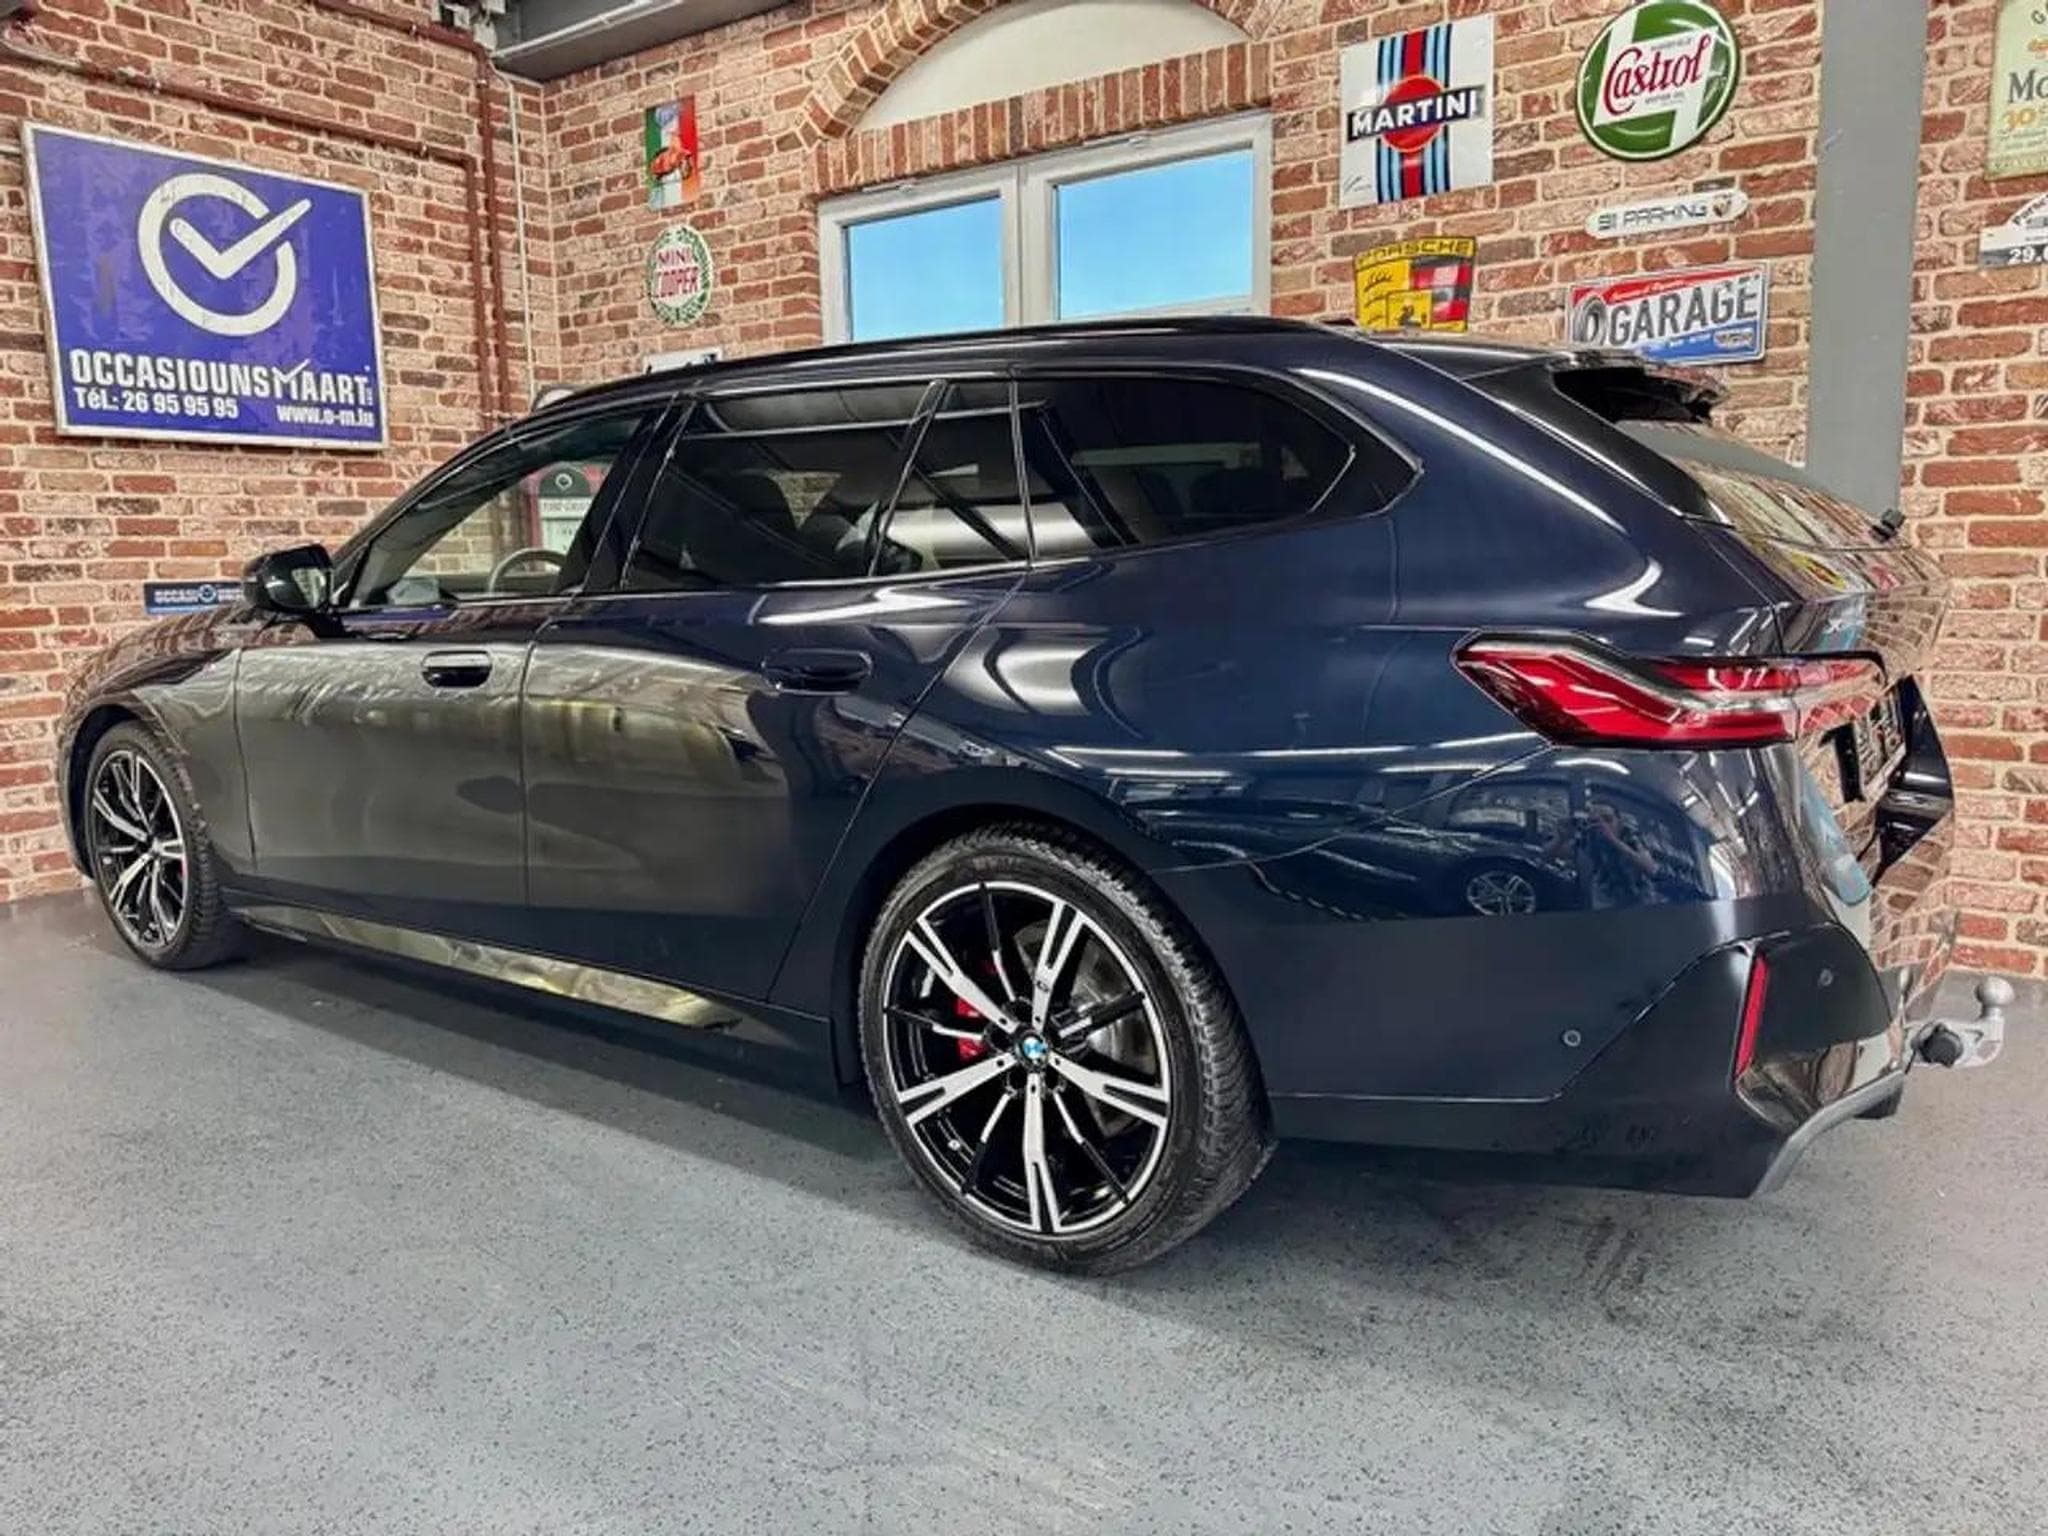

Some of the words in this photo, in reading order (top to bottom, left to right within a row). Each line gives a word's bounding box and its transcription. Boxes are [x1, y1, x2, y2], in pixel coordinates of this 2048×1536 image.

[1603, 34, 1712, 116] Castrol
[1352, 90, 1477, 137] MARTINI
[1623, 201, 1708, 227] PARKING
[658, 246, 692, 264] MINI
[1359, 240, 1470, 266] PORSCHE
[655, 266, 699, 298] COOPER
[1608, 274, 1759, 347] GARAGE
[69, 348, 369, 406] OCCASIOUNSMAART
[122, 388, 149, 413] 26
[153, 391, 180, 414] 95
[183, 394, 211, 417] 95
[213, 396, 239, 419] 95
[276, 404, 375, 428] www.o-m.lu
